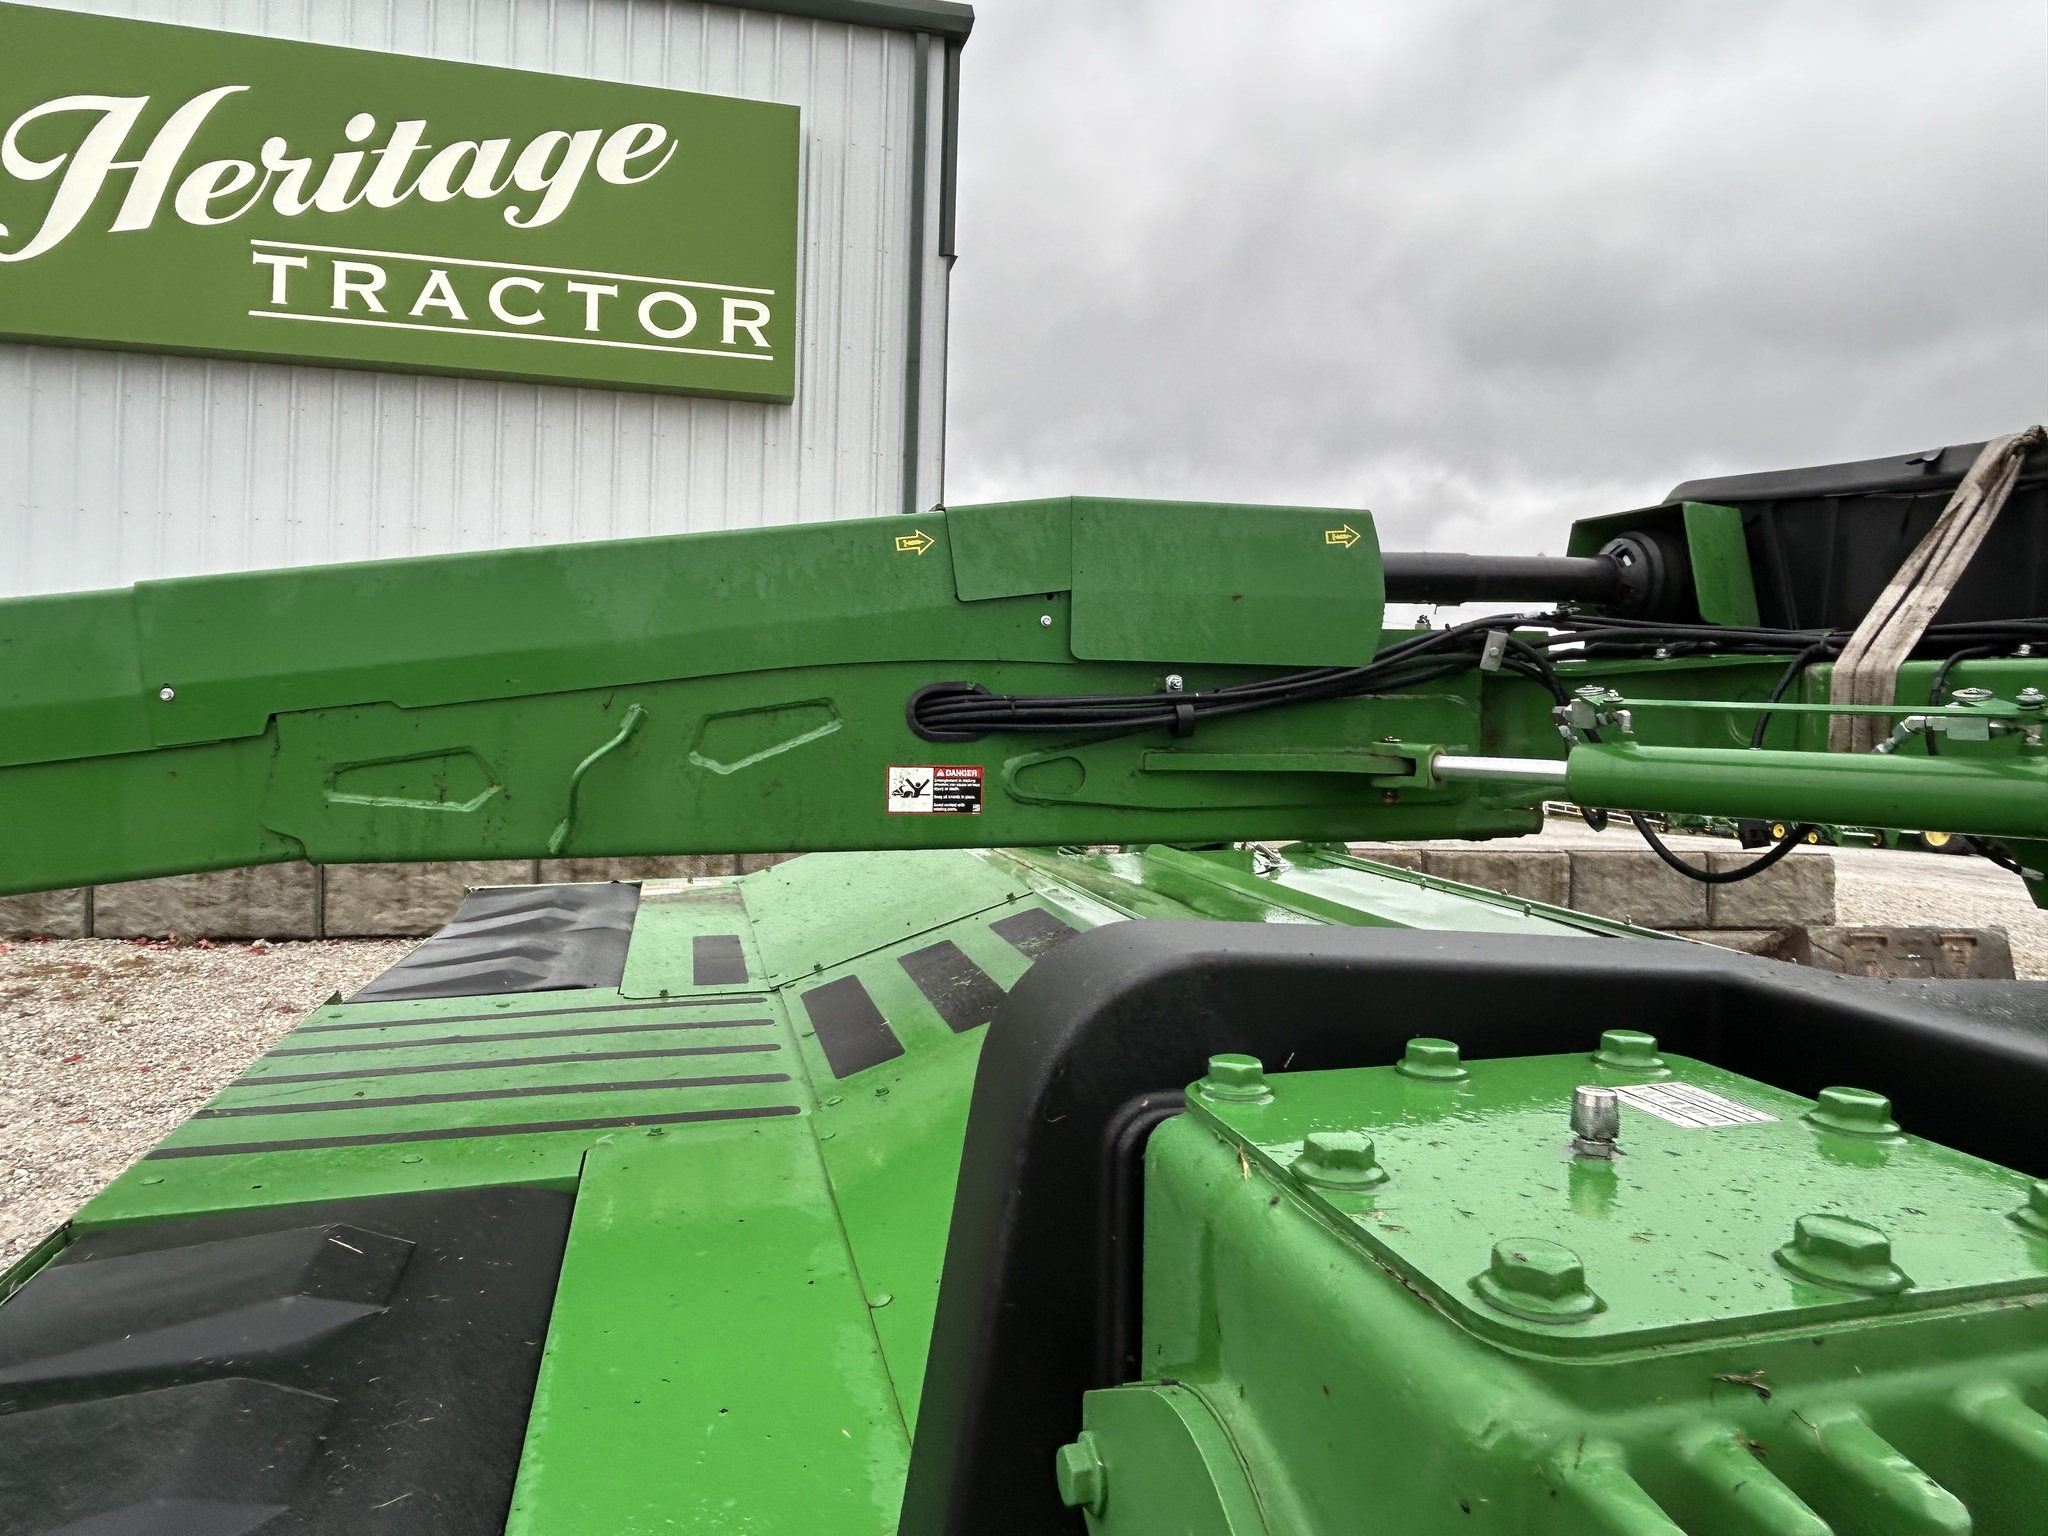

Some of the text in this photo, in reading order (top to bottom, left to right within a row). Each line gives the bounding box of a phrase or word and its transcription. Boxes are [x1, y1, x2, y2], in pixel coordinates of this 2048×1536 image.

[0, 85, 678, 262] Heritage
[252, 251, 772, 348] TRACTOR
[945, 769, 978, 777] DANGER
